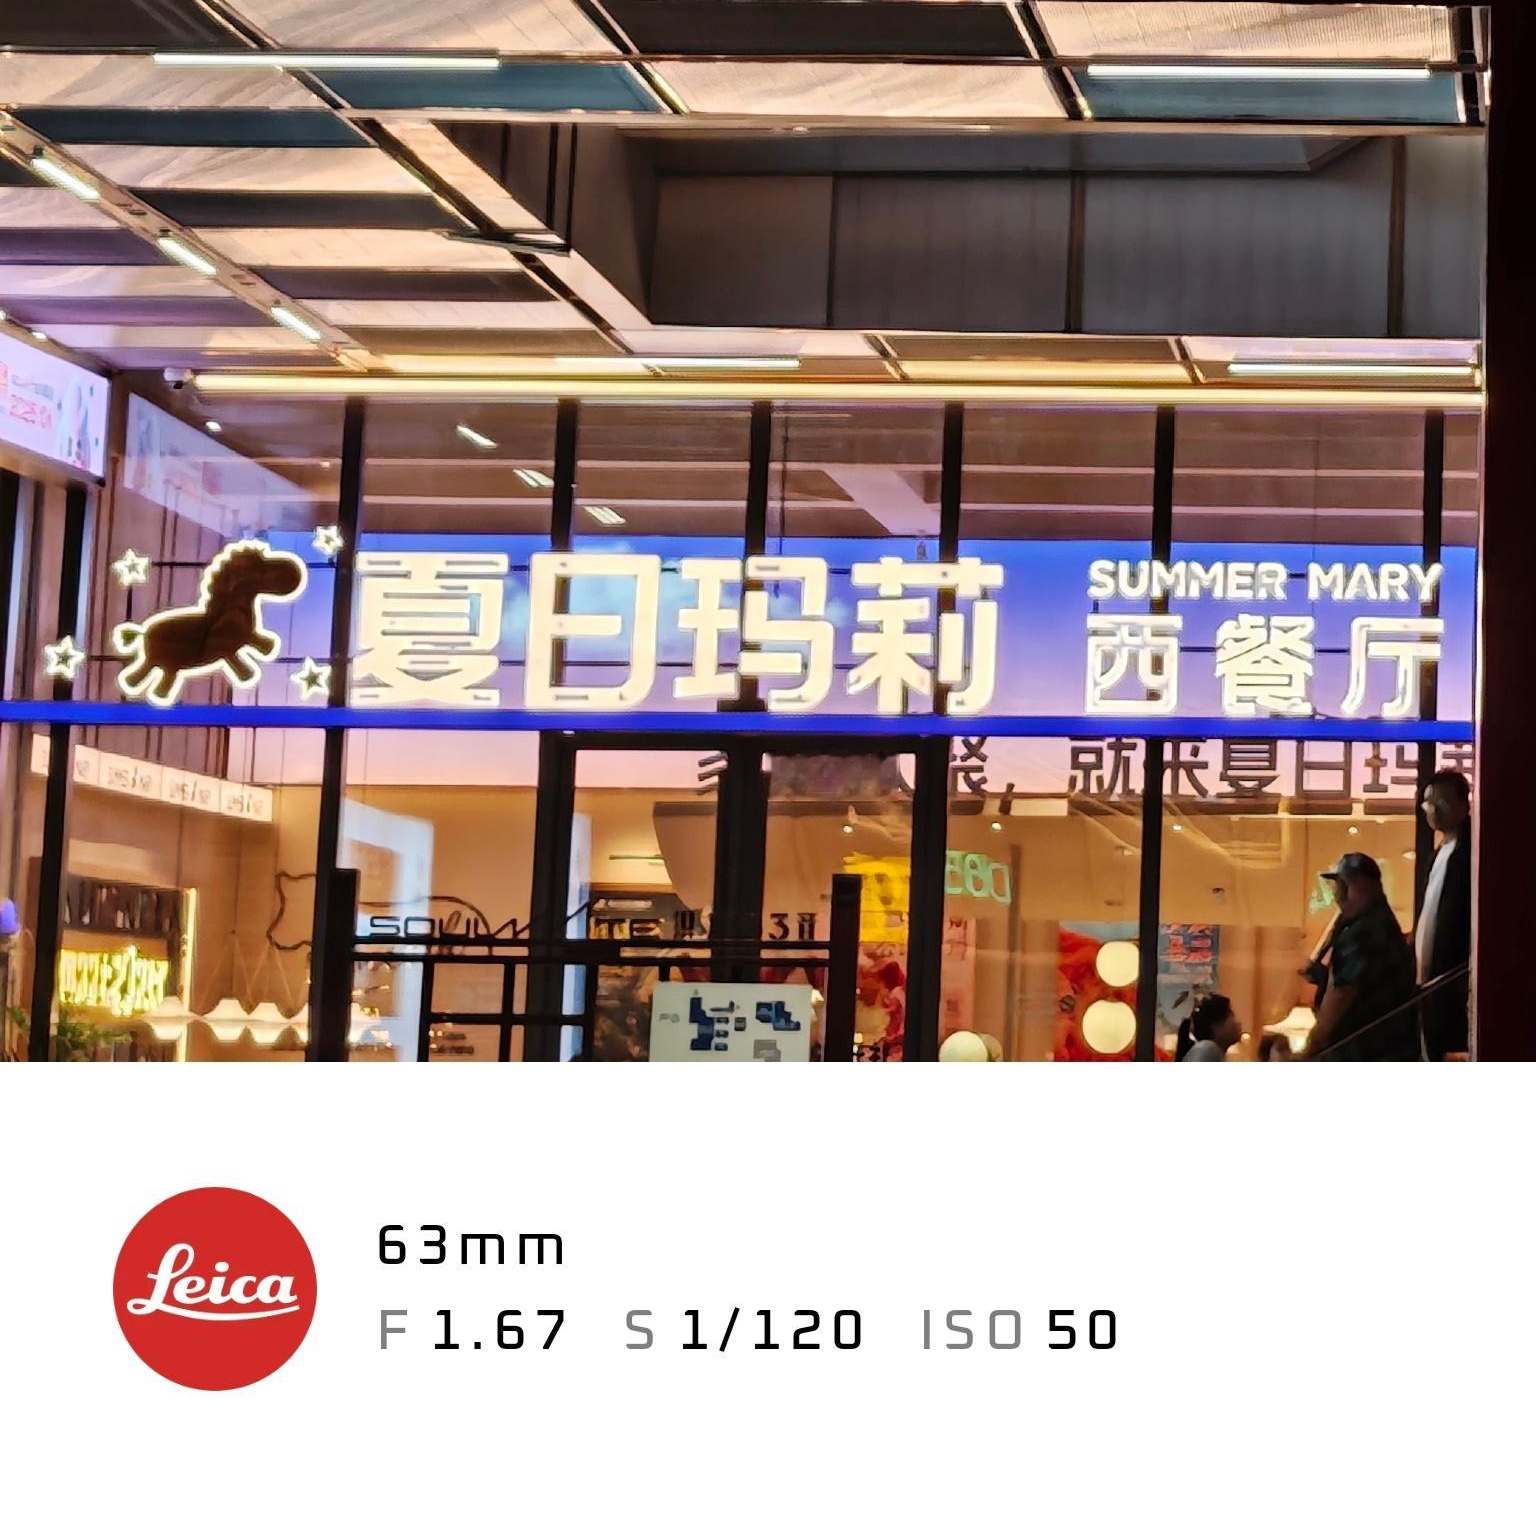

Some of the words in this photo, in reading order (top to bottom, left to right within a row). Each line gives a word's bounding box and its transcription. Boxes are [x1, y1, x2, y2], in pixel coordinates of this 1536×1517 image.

[350, 550, 1004, 716] 夏日玛莉
[1087, 558, 1289, 601] SUMMER
[1306, 560, 1444, 602] MARY
[1084, 612, 1446, 721] 西餐厅
